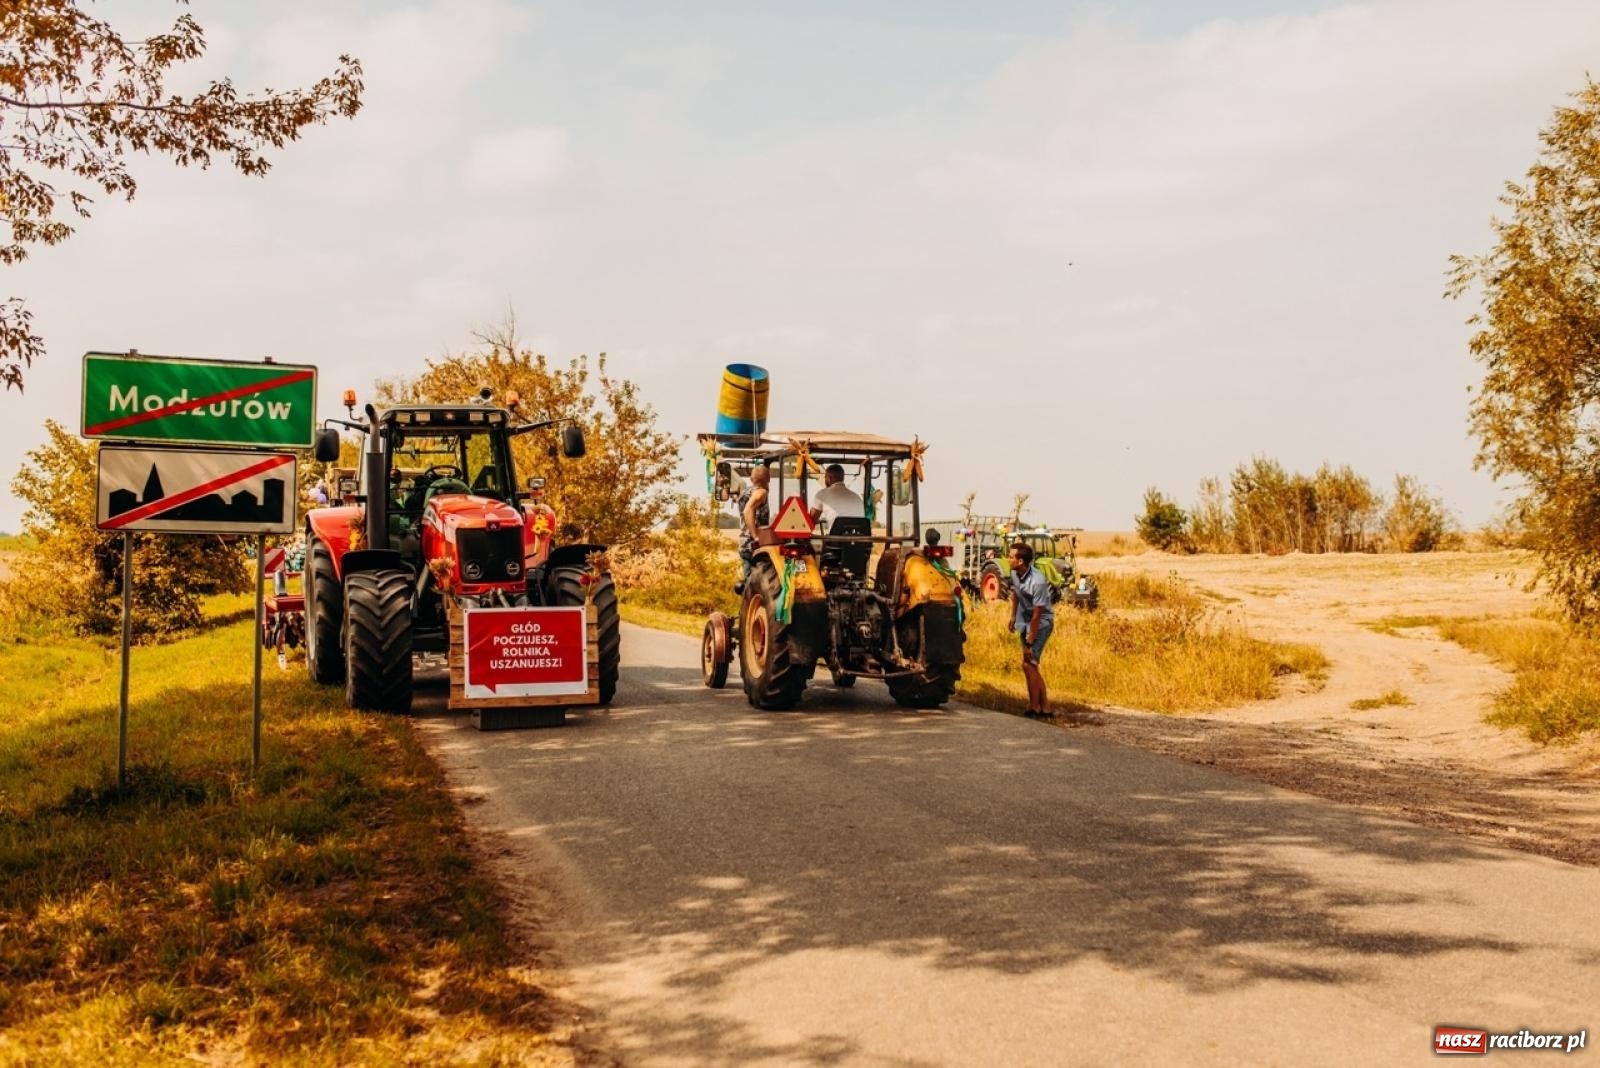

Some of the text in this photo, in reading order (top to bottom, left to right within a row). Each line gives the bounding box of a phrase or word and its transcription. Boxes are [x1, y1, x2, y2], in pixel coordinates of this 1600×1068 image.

[108, 384, 291, 420] Modzurów
[511, 621, 540, 633] GŁÓD
[493, 634, 558, 646] POCZUJESZ,
[502, 646, 550, 657] ROLNIKA
[490, 657, 562, 669] USZANUJESZ!
